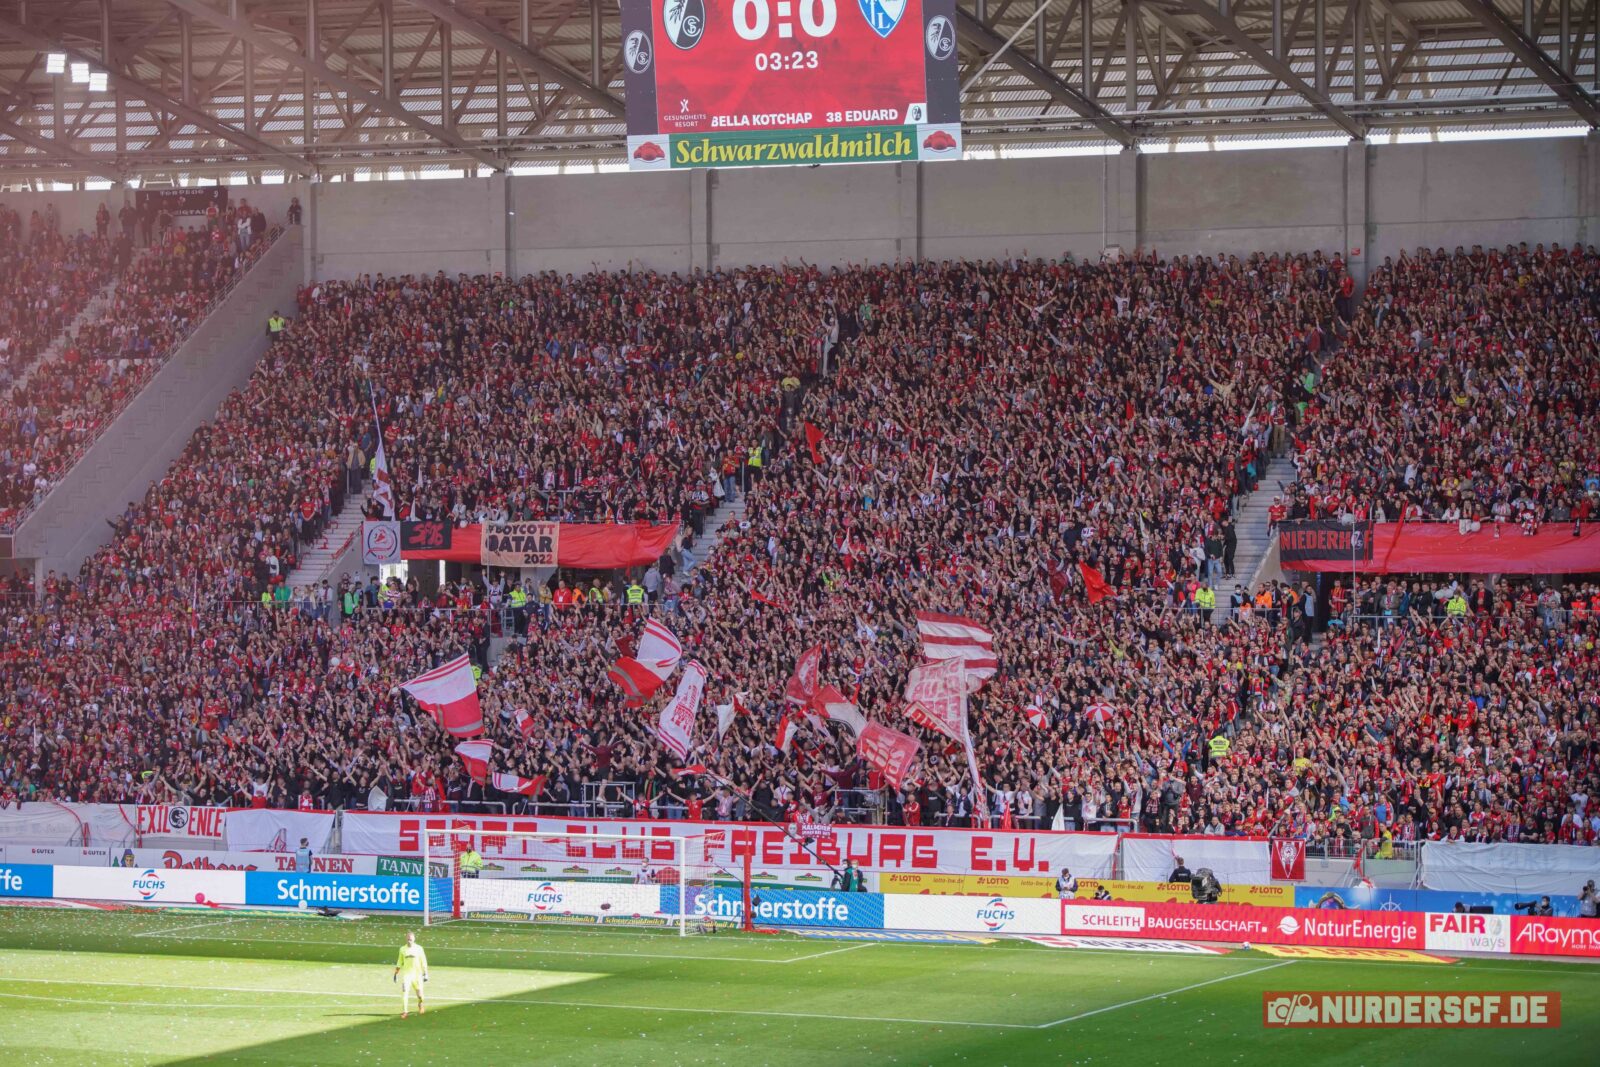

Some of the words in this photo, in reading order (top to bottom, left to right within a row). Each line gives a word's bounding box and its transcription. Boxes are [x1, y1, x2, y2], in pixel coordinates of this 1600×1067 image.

[732, 0, 837, 40] 0:0
[756, 51, 819, 72] 03:23
[711, 115, 750, 127] BELLA
[752, 113, 812, 125] KOTCHAP
[826, 111, 843, 123] 38
[845, 109, 898, 122] EDUARD
[675, 131, 912, 164] Schwarzwaldmilch
[485, 535, 553, 554] QATAR
[524, 554, 553, 565] 2022
[275, 857, 354, 873] TANEN
[132, 880, 166, 890] FUCHS
[277, 879, 420, 904] Schmierstoffe
[527, 893, 563, 903] FUCHS
[469, 911, 529, 920] Schwarzwaldmilch
[536, 913, 596, 923] Schwarzwaldmilch
[976, 909, 1015, 920] FUCHS
[1082, 914, 1140, 928] SCHLEITH
[1304, 918, 1417, 943] NaturEnergie
[1429, 914, 1486, 934] FAIR
[1470, 935, 1506, 950] ways
